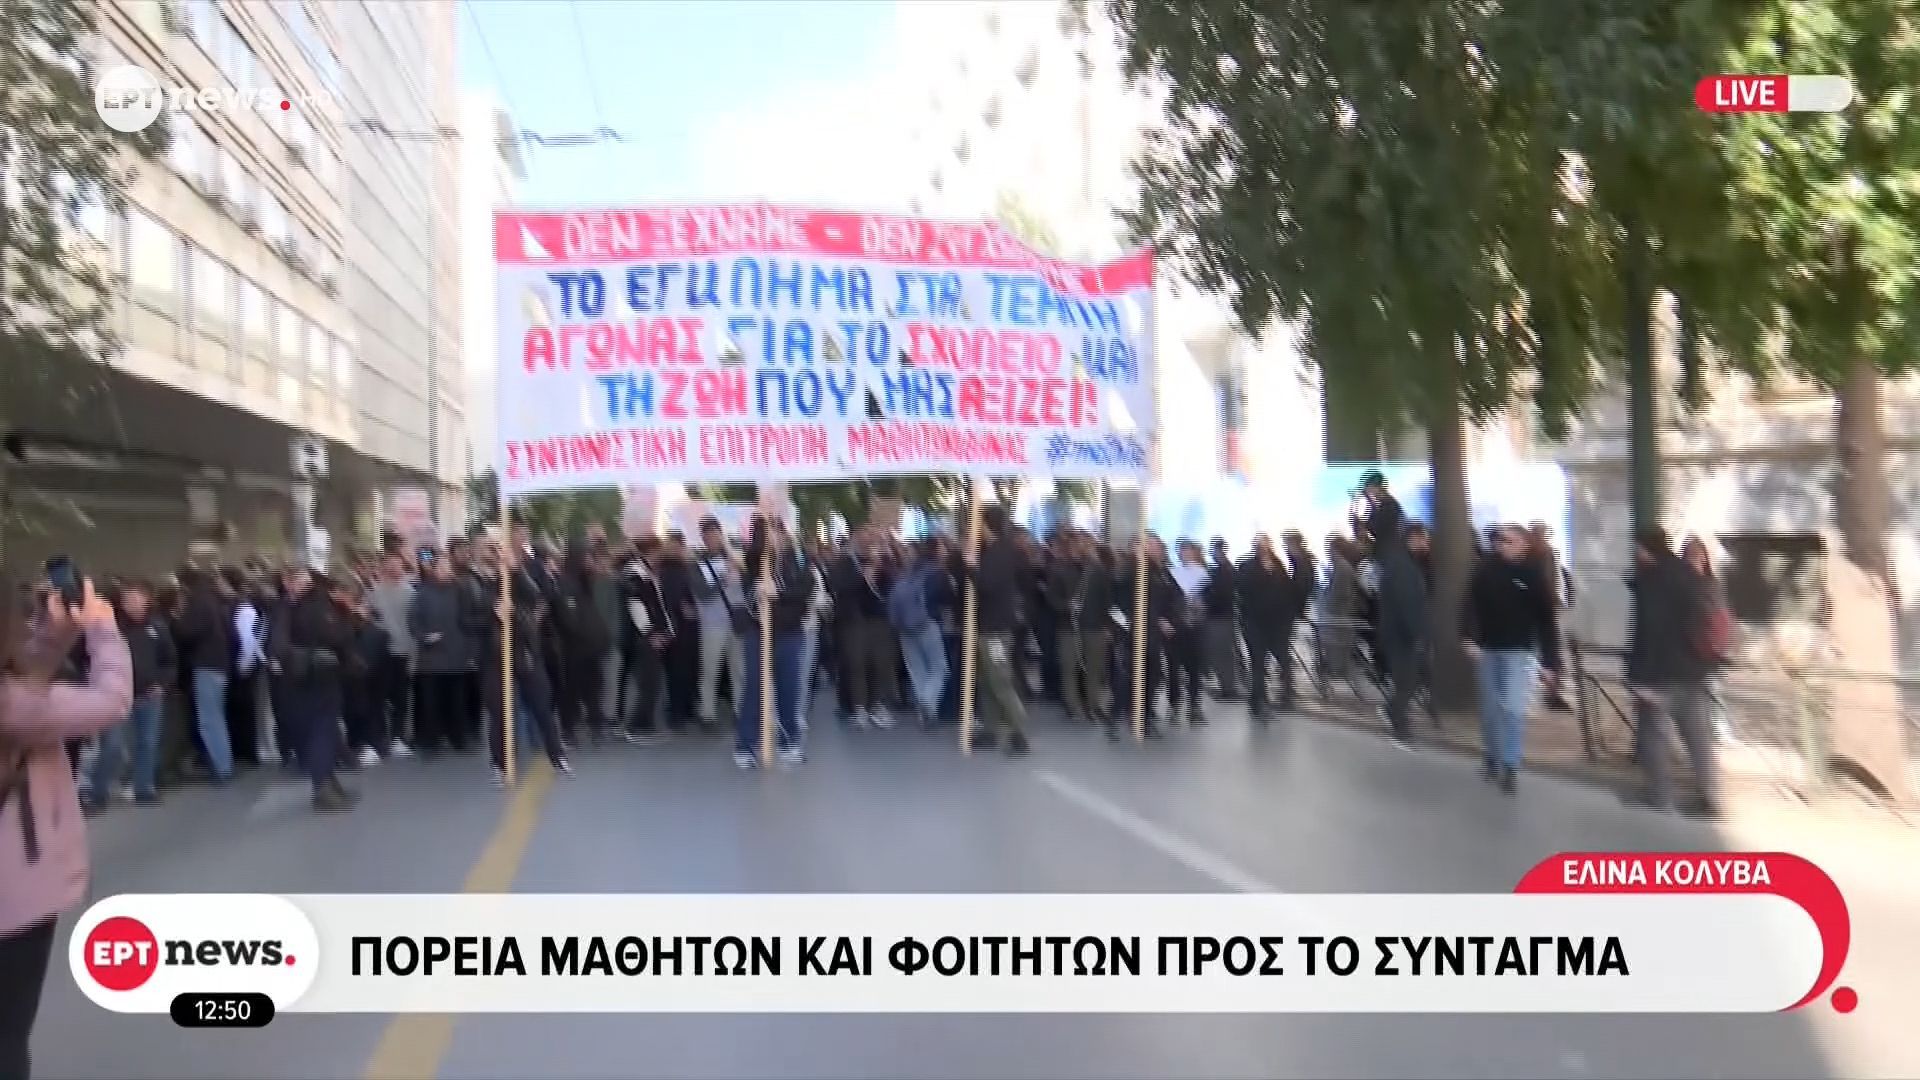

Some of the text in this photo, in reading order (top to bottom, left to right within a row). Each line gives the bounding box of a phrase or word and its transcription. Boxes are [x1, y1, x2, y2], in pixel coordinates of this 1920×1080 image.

[546, 269, 606, 318] ΤΟ
[895, 269, 962, 316] ΣΤΑ
[523, 316, 705, 374] ΑΓΩΝΑΣ
[727, 315, 815, 366] ΓΙΑ
[841, 321, 891, 367] ΤΟ
[907, 322, 1064, 374] ΣΧΟΛΕΙΟ
[596, 369, 655, 422] ΤΗ
[657, 368, 749, 420] ΖΩΗ
[755, 367, 857, 418] ΠΟΥ
[882, 368, 955, 418] ΜΑΣ
